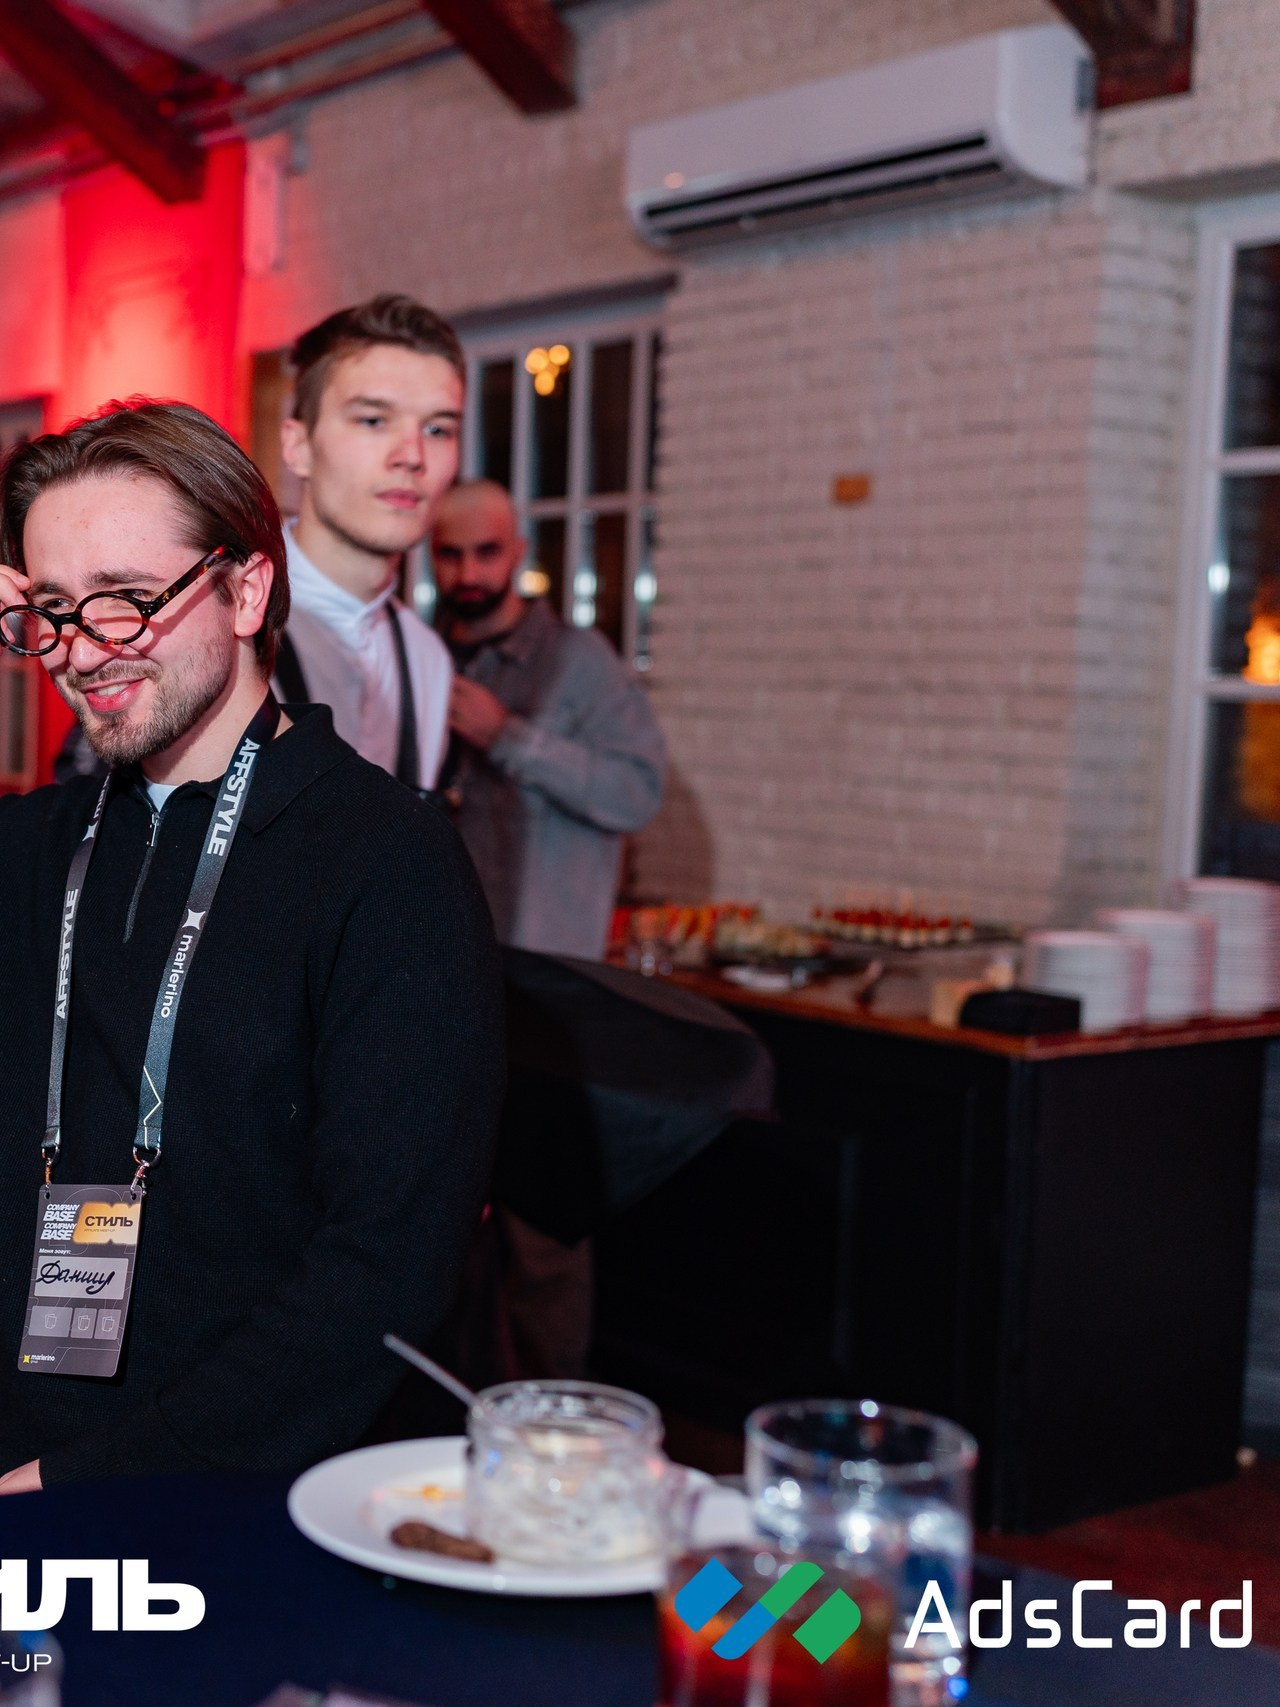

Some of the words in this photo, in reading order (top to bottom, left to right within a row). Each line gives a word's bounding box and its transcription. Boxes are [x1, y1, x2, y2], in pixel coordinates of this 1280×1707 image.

[207, 737, 262, 857] AFFSTYLE
[55, 888, 79, 1019] AFFSTYLE
[160, 934, 193, 1018] marlerino
[46, 1203, 80, 1211] COMPANY
[43, 1210, 76, 1222] BASE
[84, 1215, 134, 1227] СТИЛЬ
[44, 1222, 77, 1230] COMPANY
[40, 1229, 73, 1241] BASE
[30, 1353, 56, 1362] marlerino
